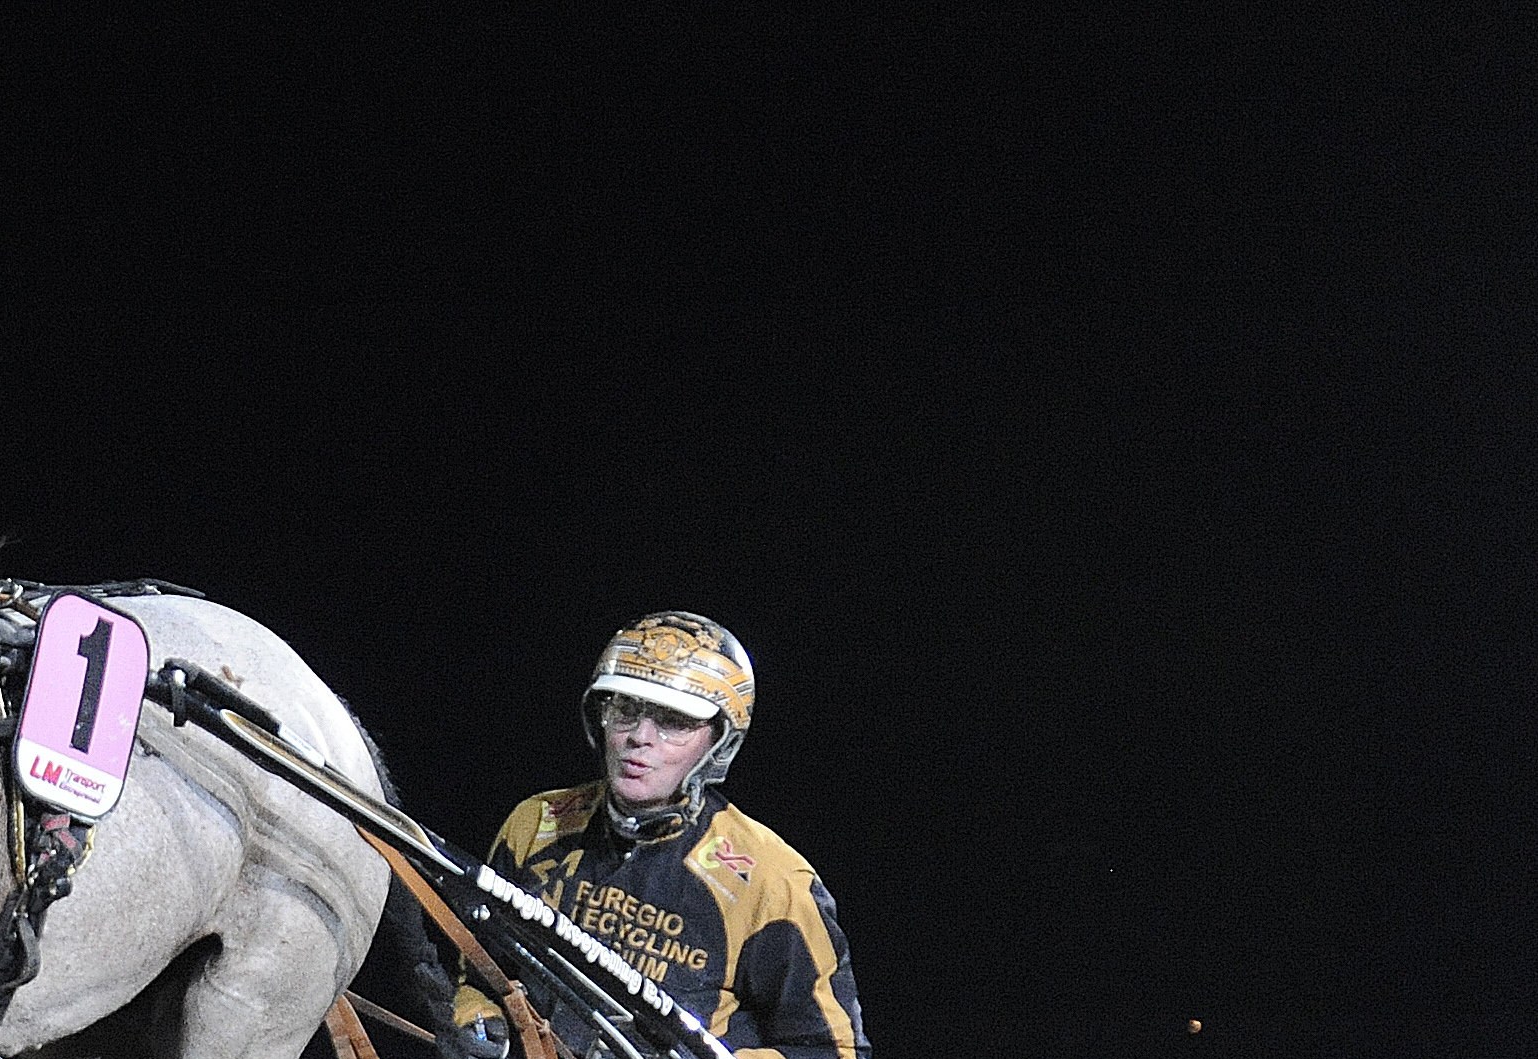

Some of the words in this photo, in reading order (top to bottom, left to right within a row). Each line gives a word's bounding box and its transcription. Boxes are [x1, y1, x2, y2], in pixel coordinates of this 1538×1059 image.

[69, 615, 114, 755] 1
[29, 754, 63, 786] LM
[64, 768, 107, 795] Transport
[477, 863, 555, 928] Euregio
